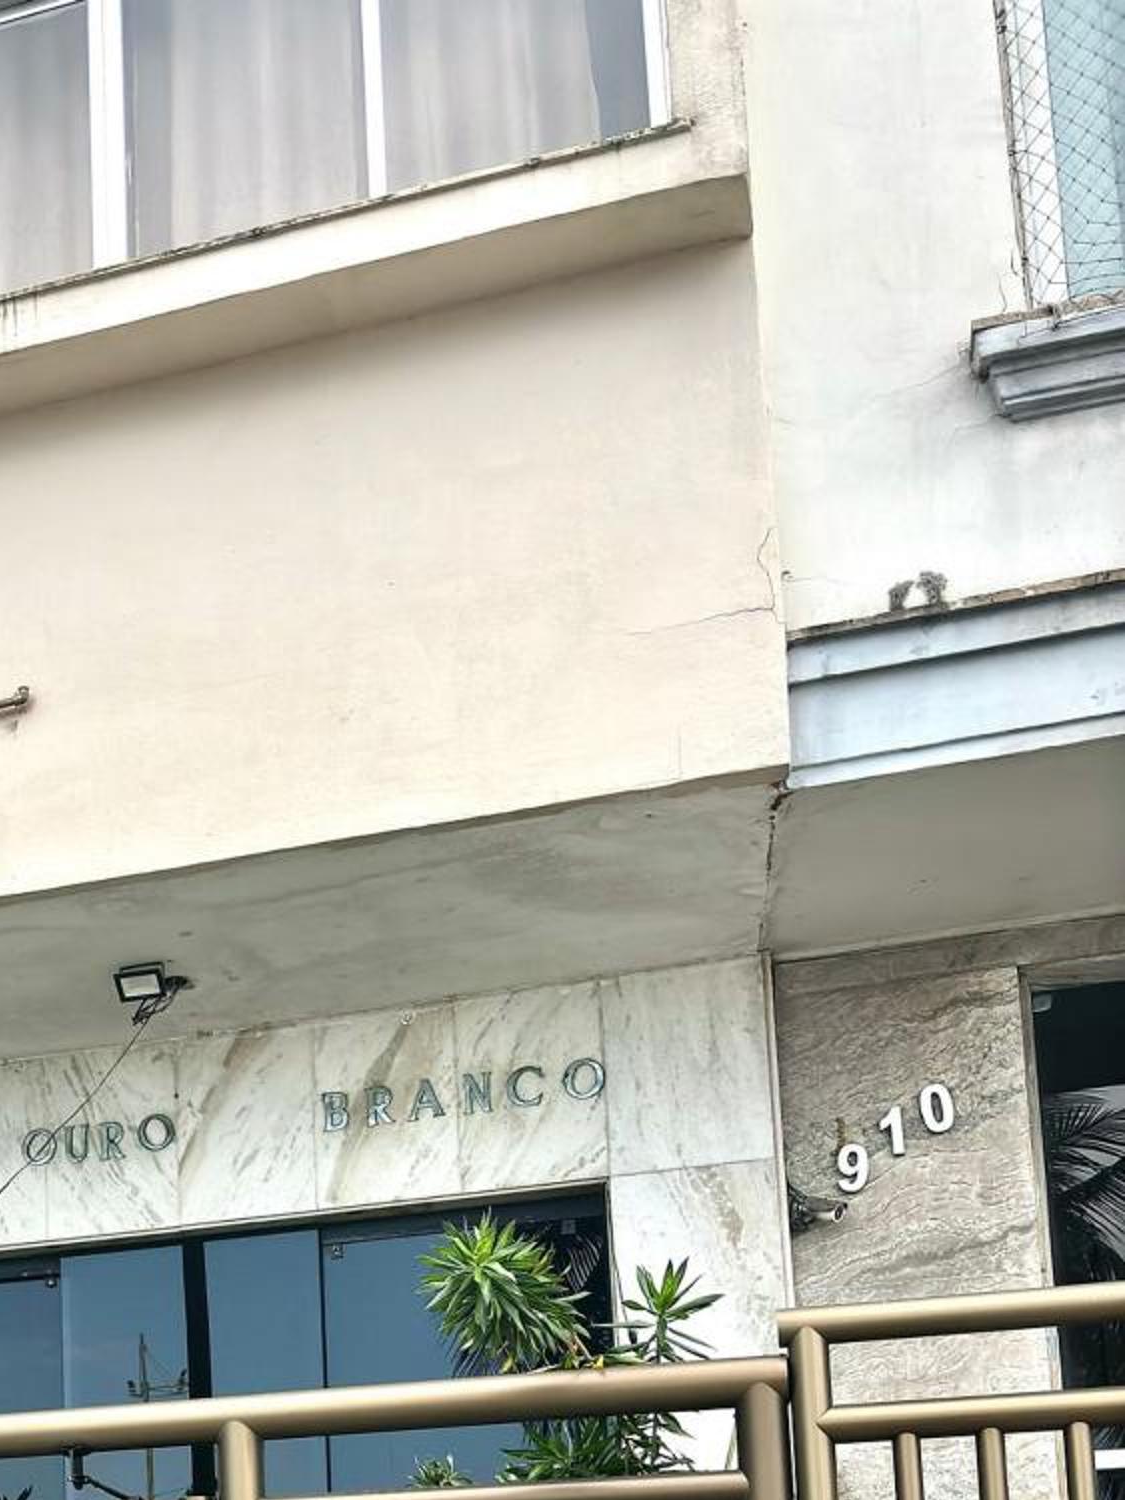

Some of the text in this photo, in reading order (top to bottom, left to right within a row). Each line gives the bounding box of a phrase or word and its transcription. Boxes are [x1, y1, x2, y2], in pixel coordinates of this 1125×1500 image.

[22, 1112, 177, 1167] OURO
[321, 1057, 606, 1133] BRANCO
[837, 1083, 954, 1193] 910
